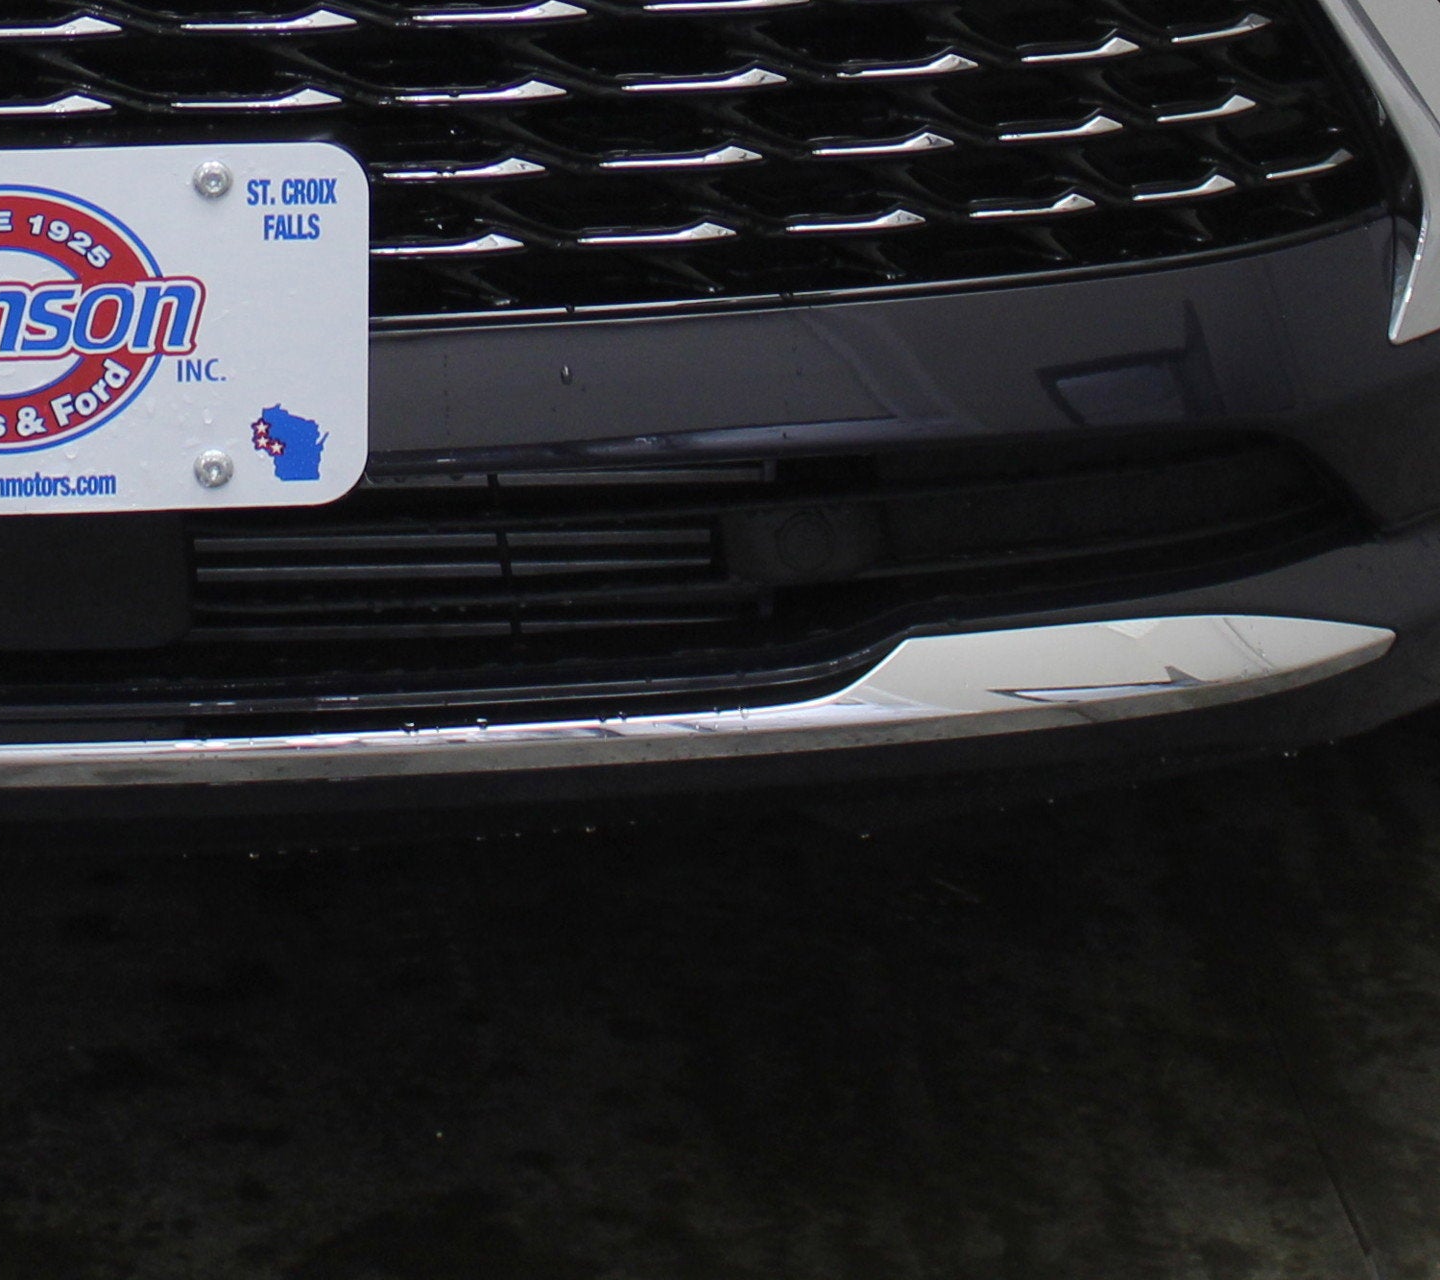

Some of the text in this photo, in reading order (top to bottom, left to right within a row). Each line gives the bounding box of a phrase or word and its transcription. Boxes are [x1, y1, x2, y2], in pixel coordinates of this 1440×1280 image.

[246, 177, 337, 206] ST. CROIX
[28, 214, 113, 269] 1925
[263, 213, 320, 241] FALLS
[177, 358, 227, 382] INC.
[16, 405, 47, 437] &
[49, 358, 131, 427] Ford
